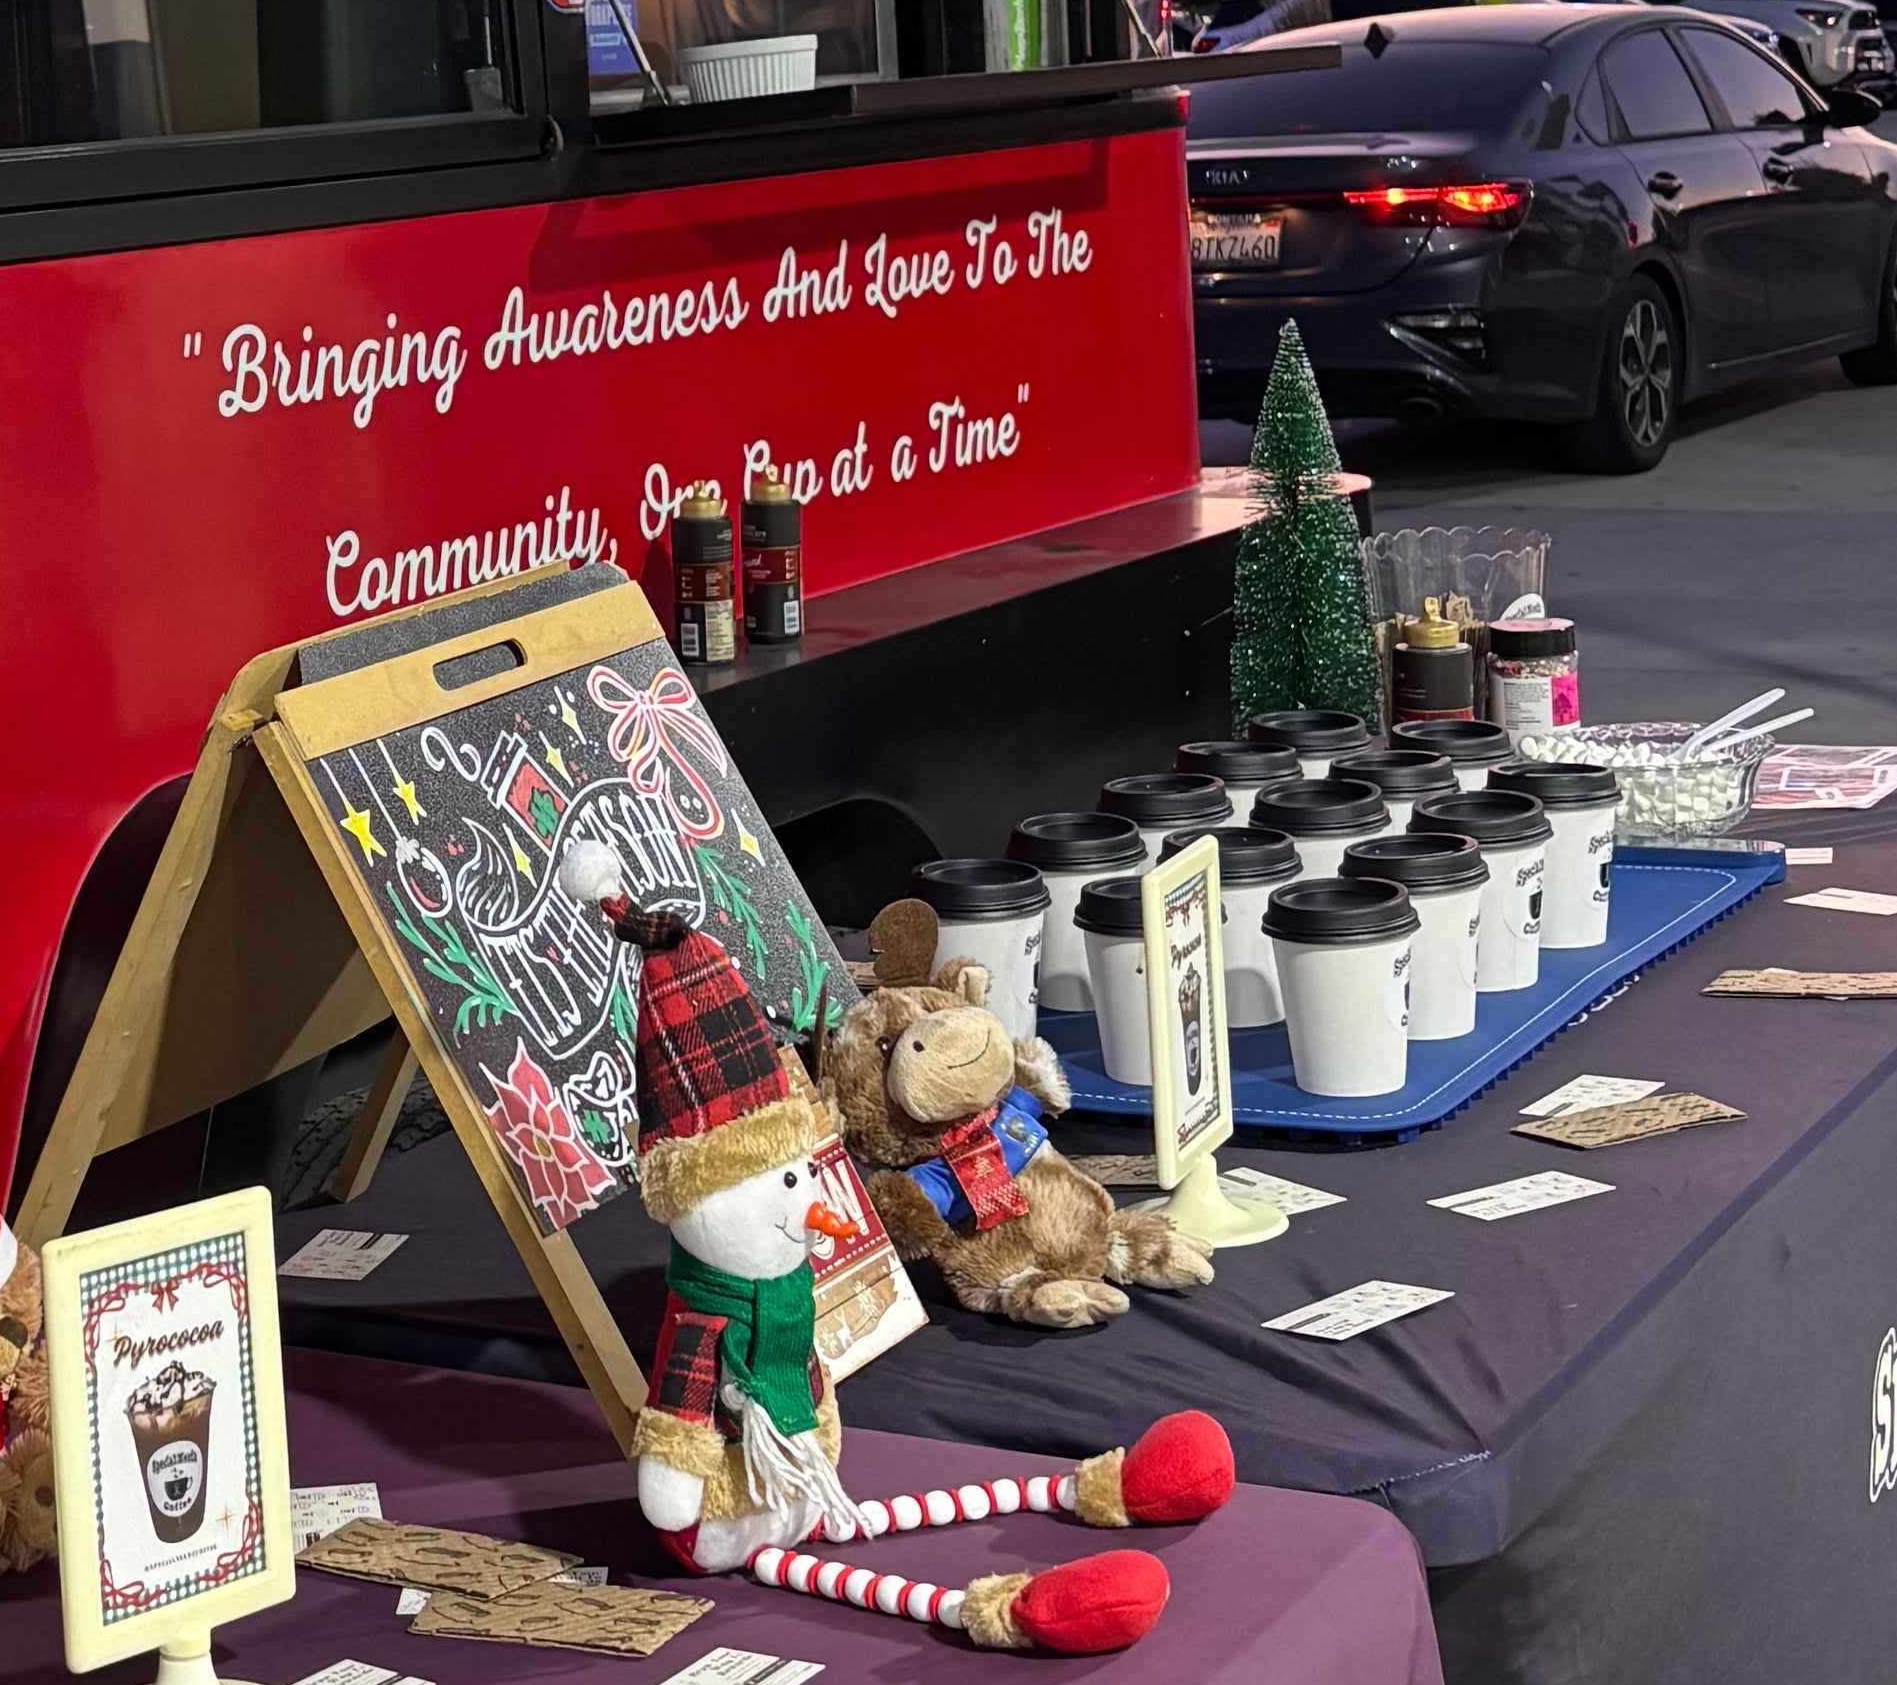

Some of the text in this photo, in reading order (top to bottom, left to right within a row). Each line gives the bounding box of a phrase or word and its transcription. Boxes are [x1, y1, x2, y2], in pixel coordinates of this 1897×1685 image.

[485, 276, 748, 370] Awareness
[763, 246, 851, 321] And
[864, 233, 955, 319] Love
[966, 213, 1017, 290] To
[1028, 207, 1093, 277] The
[830, 422, 871, 503] at
[890, 435, 916, 480] a
[113, 1320, 224, 1370] Pyrococoa
